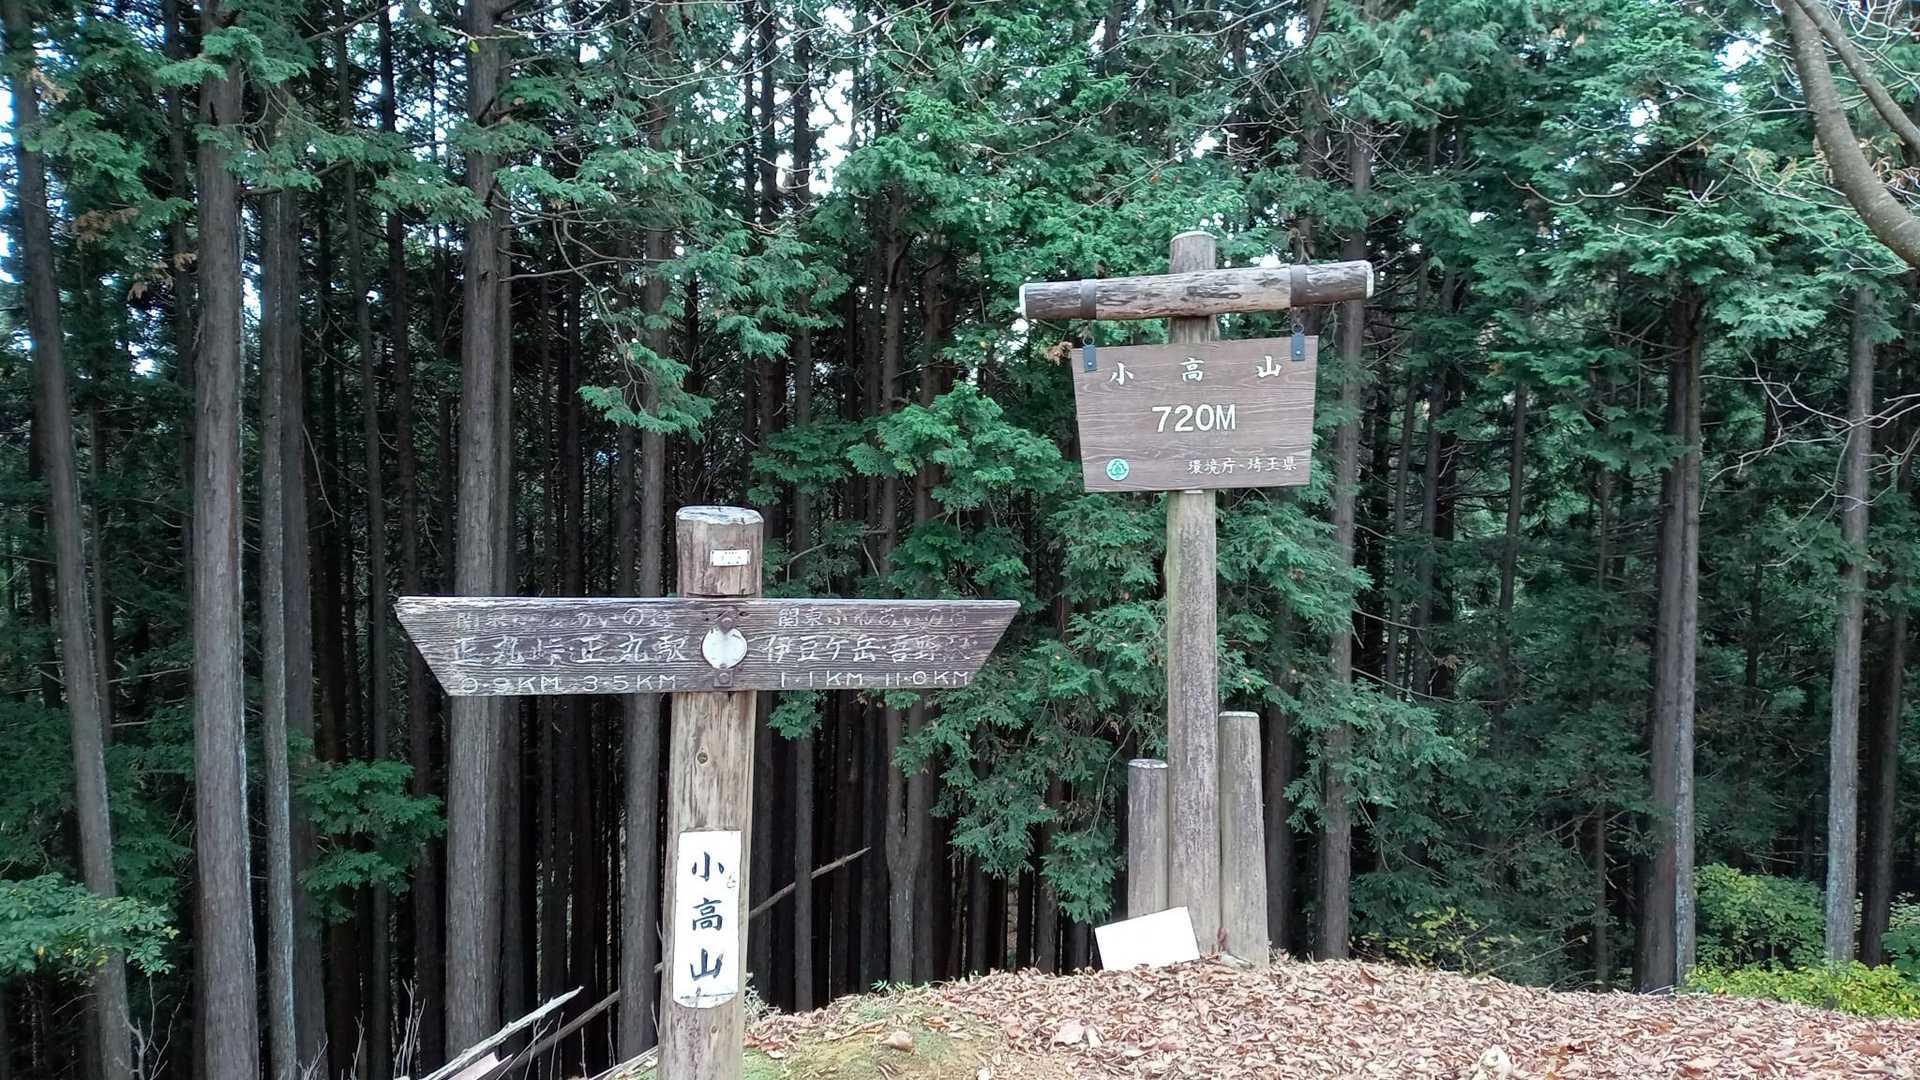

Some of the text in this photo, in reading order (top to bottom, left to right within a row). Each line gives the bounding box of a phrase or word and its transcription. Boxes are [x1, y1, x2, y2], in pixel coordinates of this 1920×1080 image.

[1109, 355, 1282, 386] 小高山
[1152, 403, 1236, 433] 720M
[690, 850, 725, 982] 小高山
